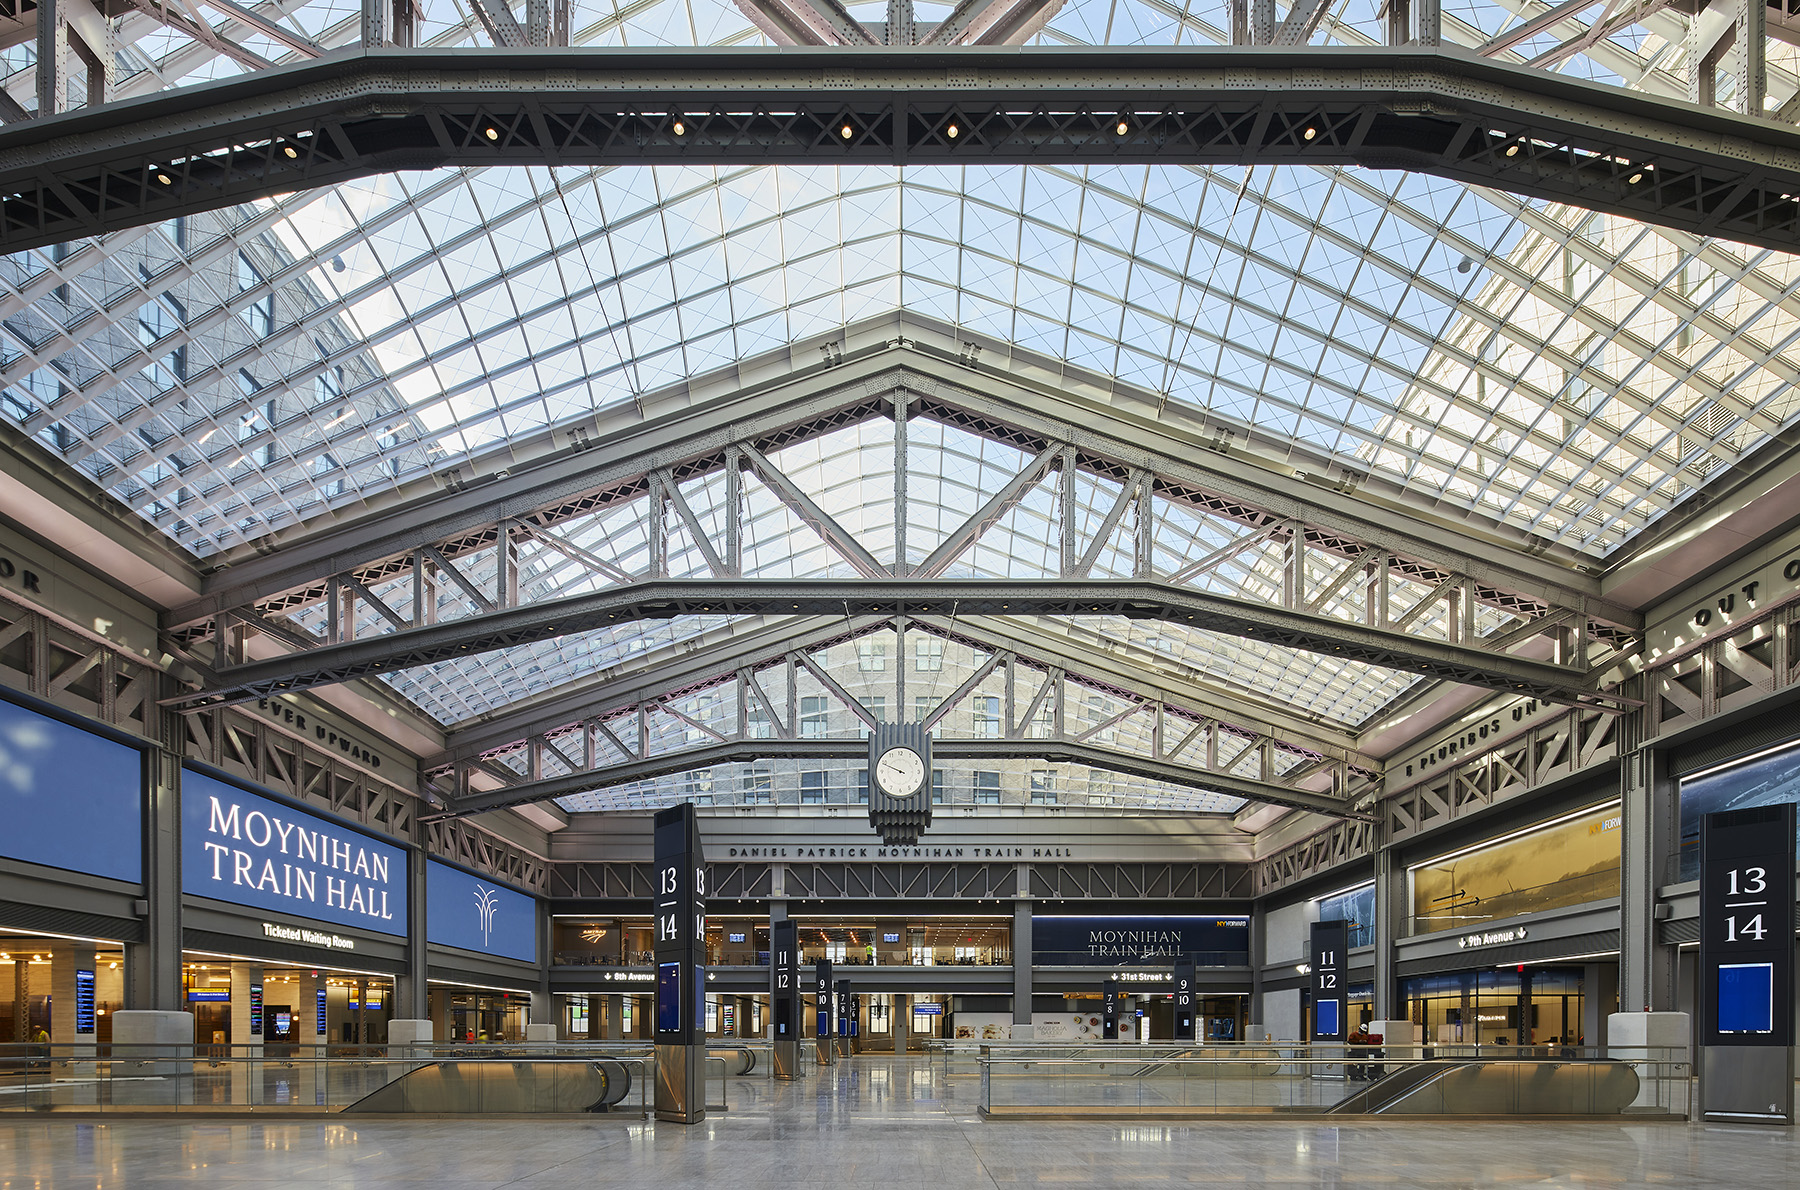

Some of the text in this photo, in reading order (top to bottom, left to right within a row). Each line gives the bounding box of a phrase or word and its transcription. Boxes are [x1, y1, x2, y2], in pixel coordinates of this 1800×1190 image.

[1695, 581, 1759, 627] OUT
[258, 699, 381, 768] EVER UPWARD
[1405, 764, 1413, 777] E
[1420, 719, 1500, 769] PLURIBUS
[208, 796, 389, 884] MOYNIHAN
[729, 848, 1072, 857] DANIEL PATRICK MOYNIHAN TRAIN HALL
[205, 841, 393, 920] TRAIN HALL
[660, 866, 677, 895] 13
[695, 867, 705, 896] 13
[1726, 866, 1767, 896] 13
[660, 913, 678, 941] 14
[695, 913, 705, 942] 14
[1724, 913, 1768, 942] 14
[263, 923, 354, 949] Ticketed Waiting Room
[1089, 930, 1182, 943] MOYNIHAN
[1468, 931, 1515, 947] 9th Avenue
[779, 950, 787, 965] 11
[1088, 944, 1184, 957] TRAIN HALL
[1320, 950, 1335, 965] 11
[614, 972, 655, 981] 8th Avenue
[777, 974, 788, 988] 12
[819, 979, 825, 989] 9
[1121, 972, 1163, 981] 31st Street
[1319, 974, 1337, 989] 12
[1180, 979, 1187, 990] 9
[818, 994, 827, 1005] 10
[1107, 994, 1112, 1002] 7
[1178, 995, 1190, 1006] 10
[840, 1005, 846, 1013] 8
[1107, 1005, 1113, 1014] 8
